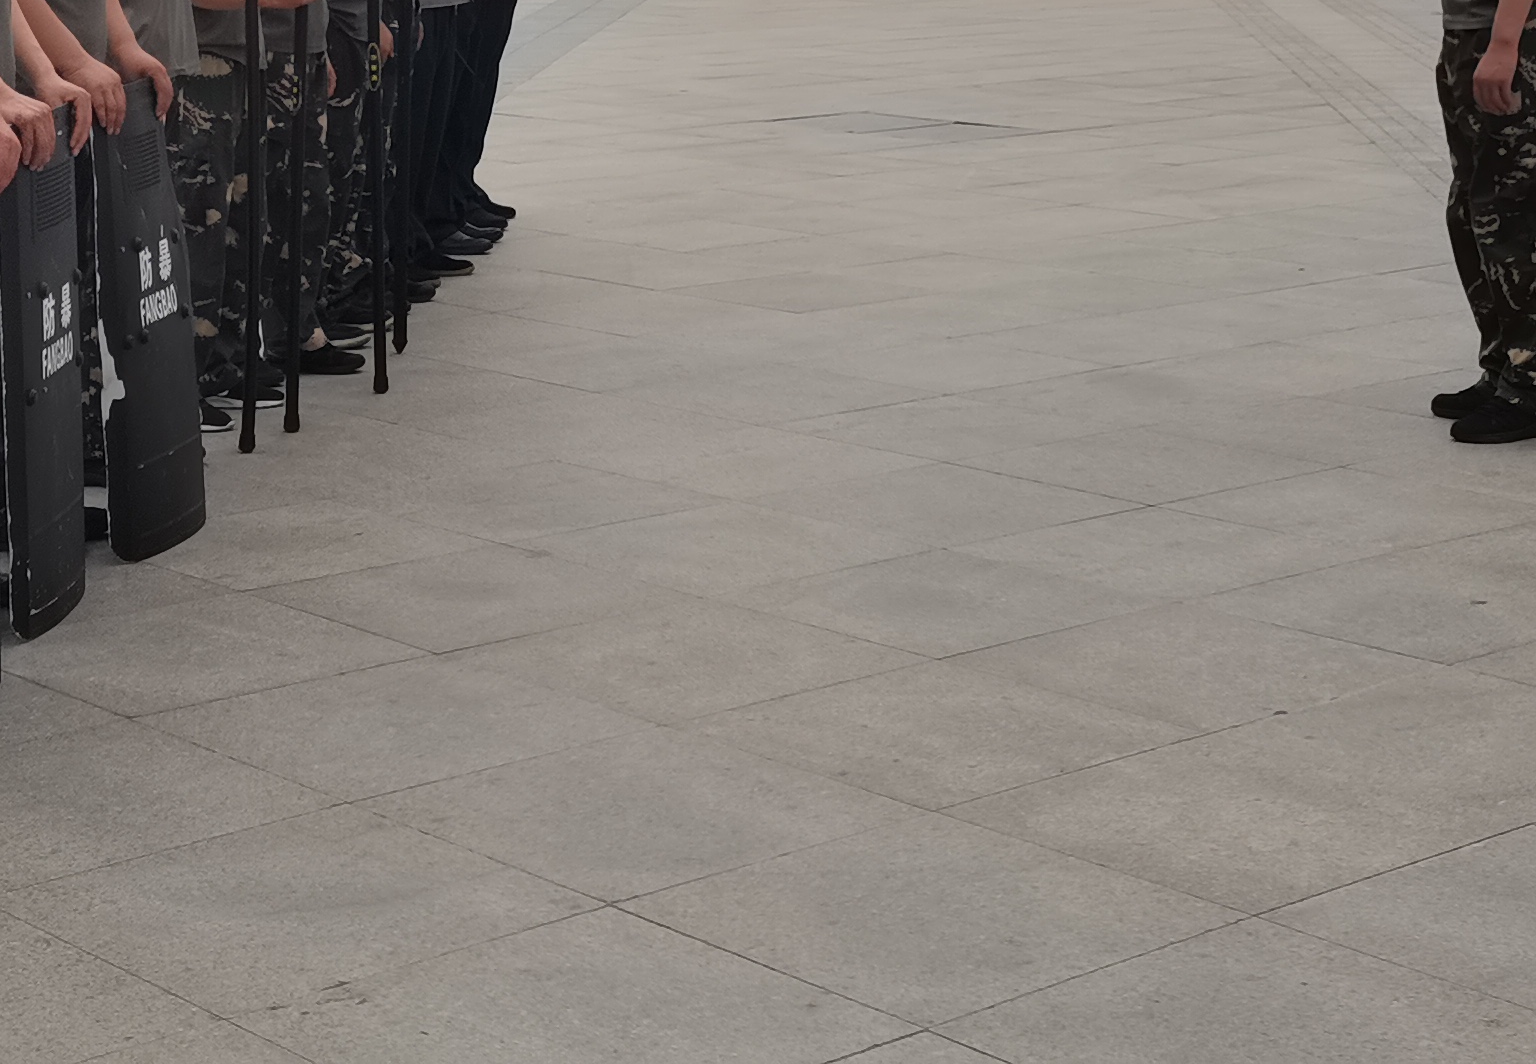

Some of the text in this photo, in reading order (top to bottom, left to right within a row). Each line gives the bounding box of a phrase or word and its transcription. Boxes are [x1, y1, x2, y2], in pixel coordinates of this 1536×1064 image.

[139, 237, 172, 292] 防暴
[42, 281, 72, 342] 防暴
[139, 283, 178, 329] FANGBAO
[41, 330, 74, 380] FANGBAO
